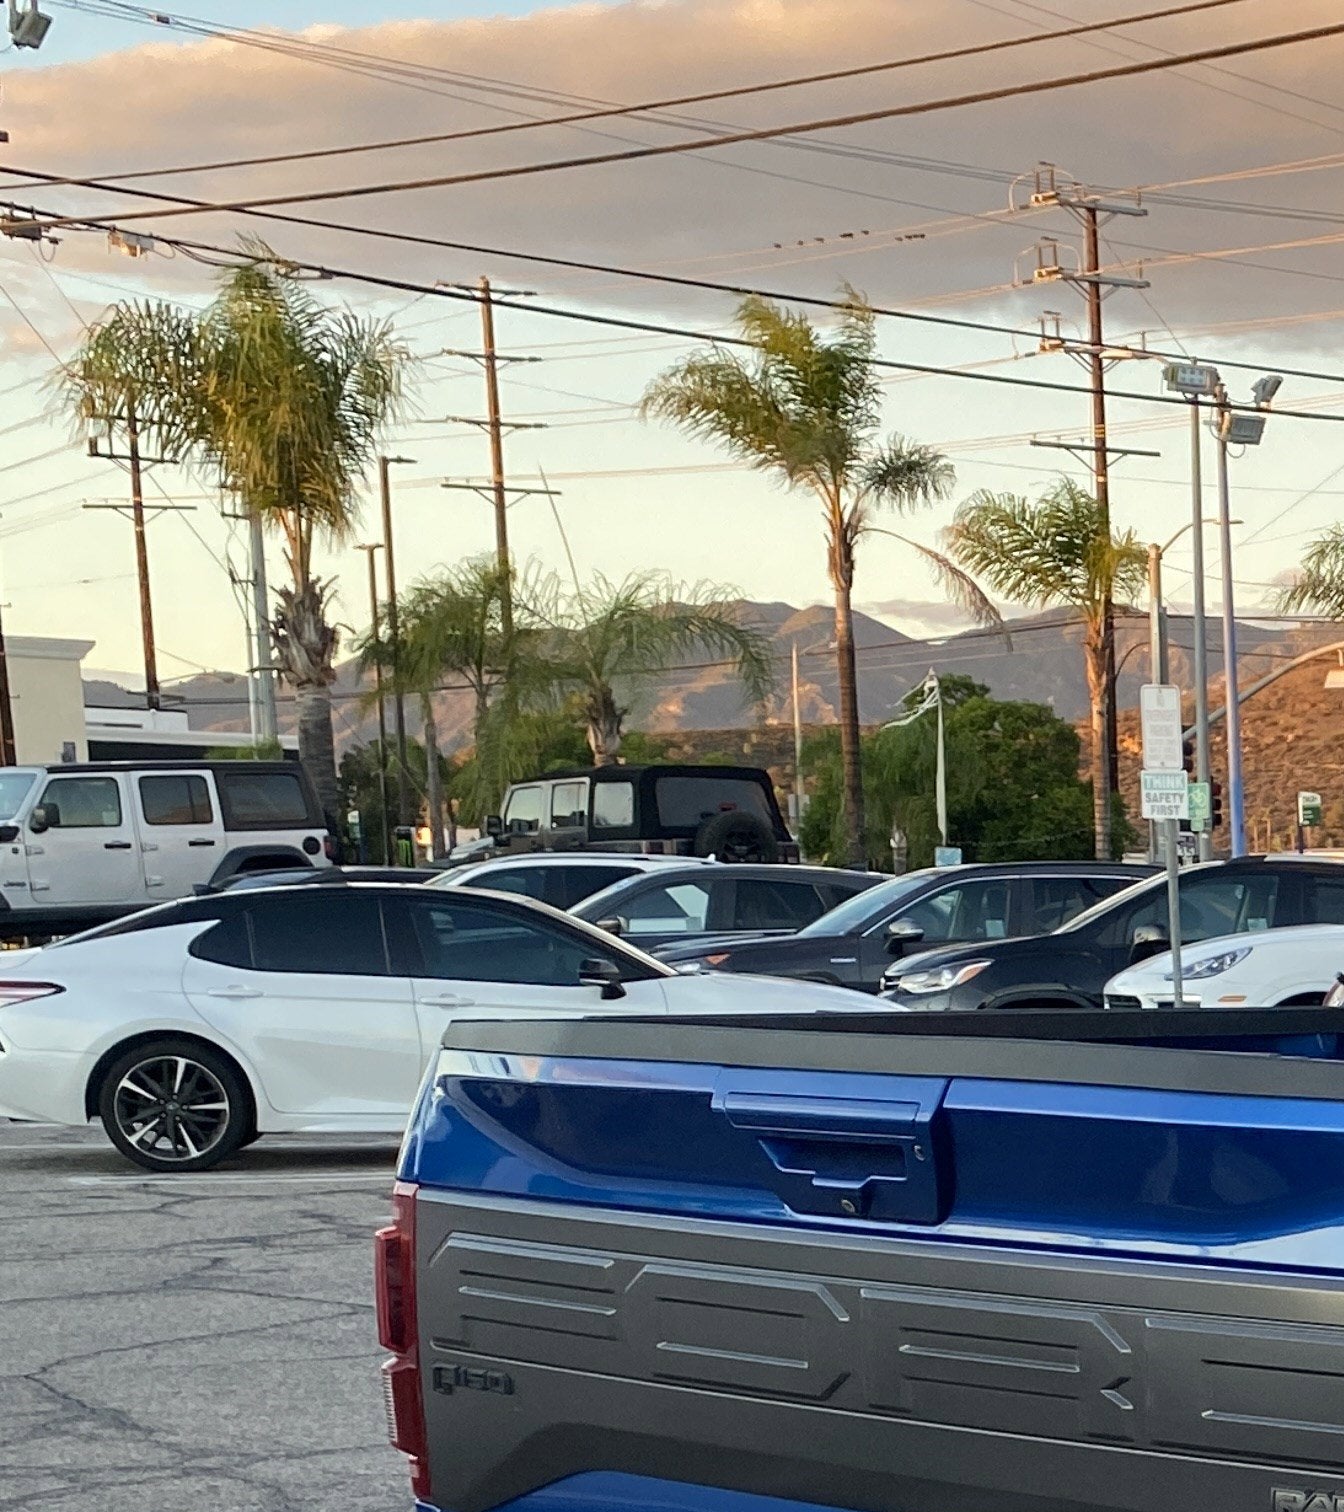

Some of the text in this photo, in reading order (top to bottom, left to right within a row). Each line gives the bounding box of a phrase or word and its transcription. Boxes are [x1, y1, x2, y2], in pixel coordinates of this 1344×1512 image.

[1143, 773, 1186, 790] THINK
[1145, 792, 1185, 804] SAFETY
[1150, 804, 1180, 816] FIRST
